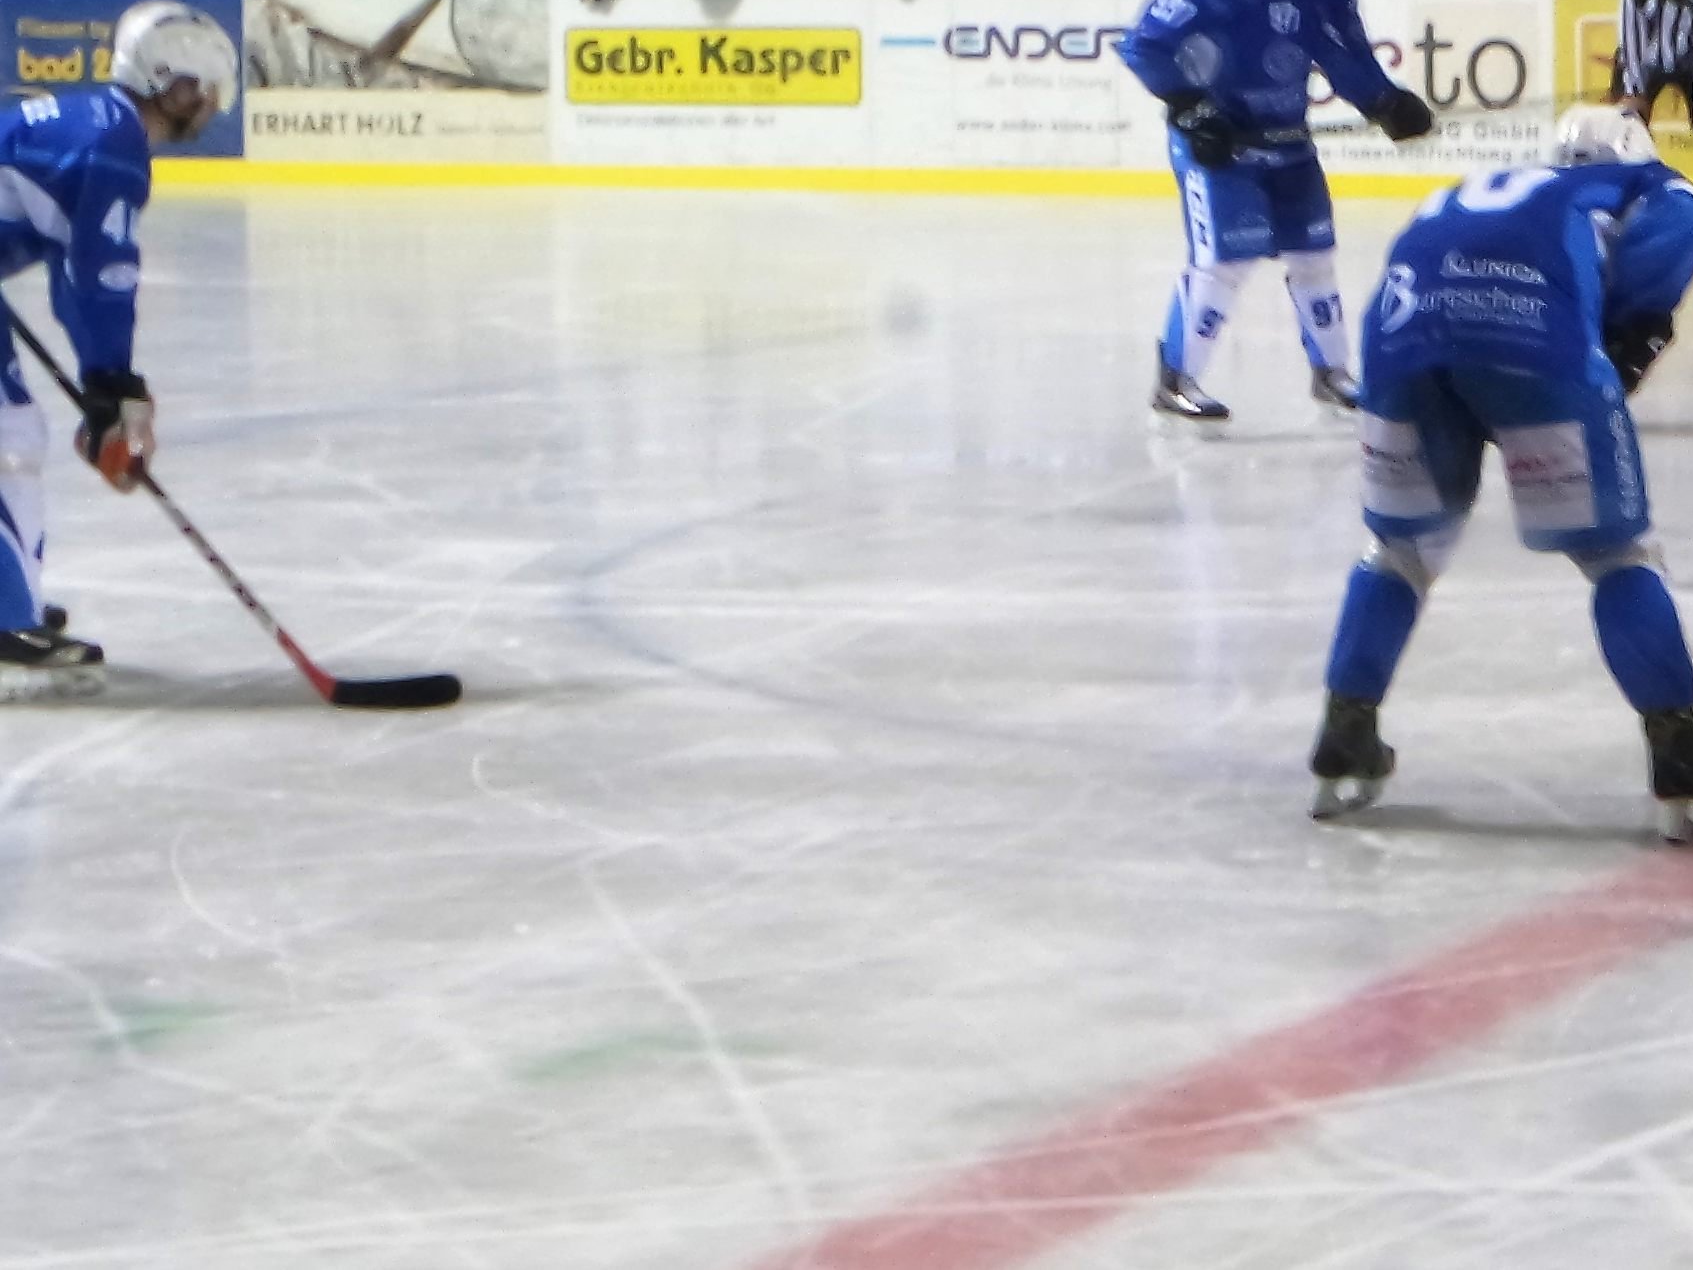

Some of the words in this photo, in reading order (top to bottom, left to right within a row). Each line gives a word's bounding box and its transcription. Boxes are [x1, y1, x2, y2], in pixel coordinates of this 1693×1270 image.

[575, 36, 684, 75] Gebr.
[700, 36, 851, 82] Kasper
[252, 113, 346, 135] ERHART
[356, 113, 423, 135] HOLZ
